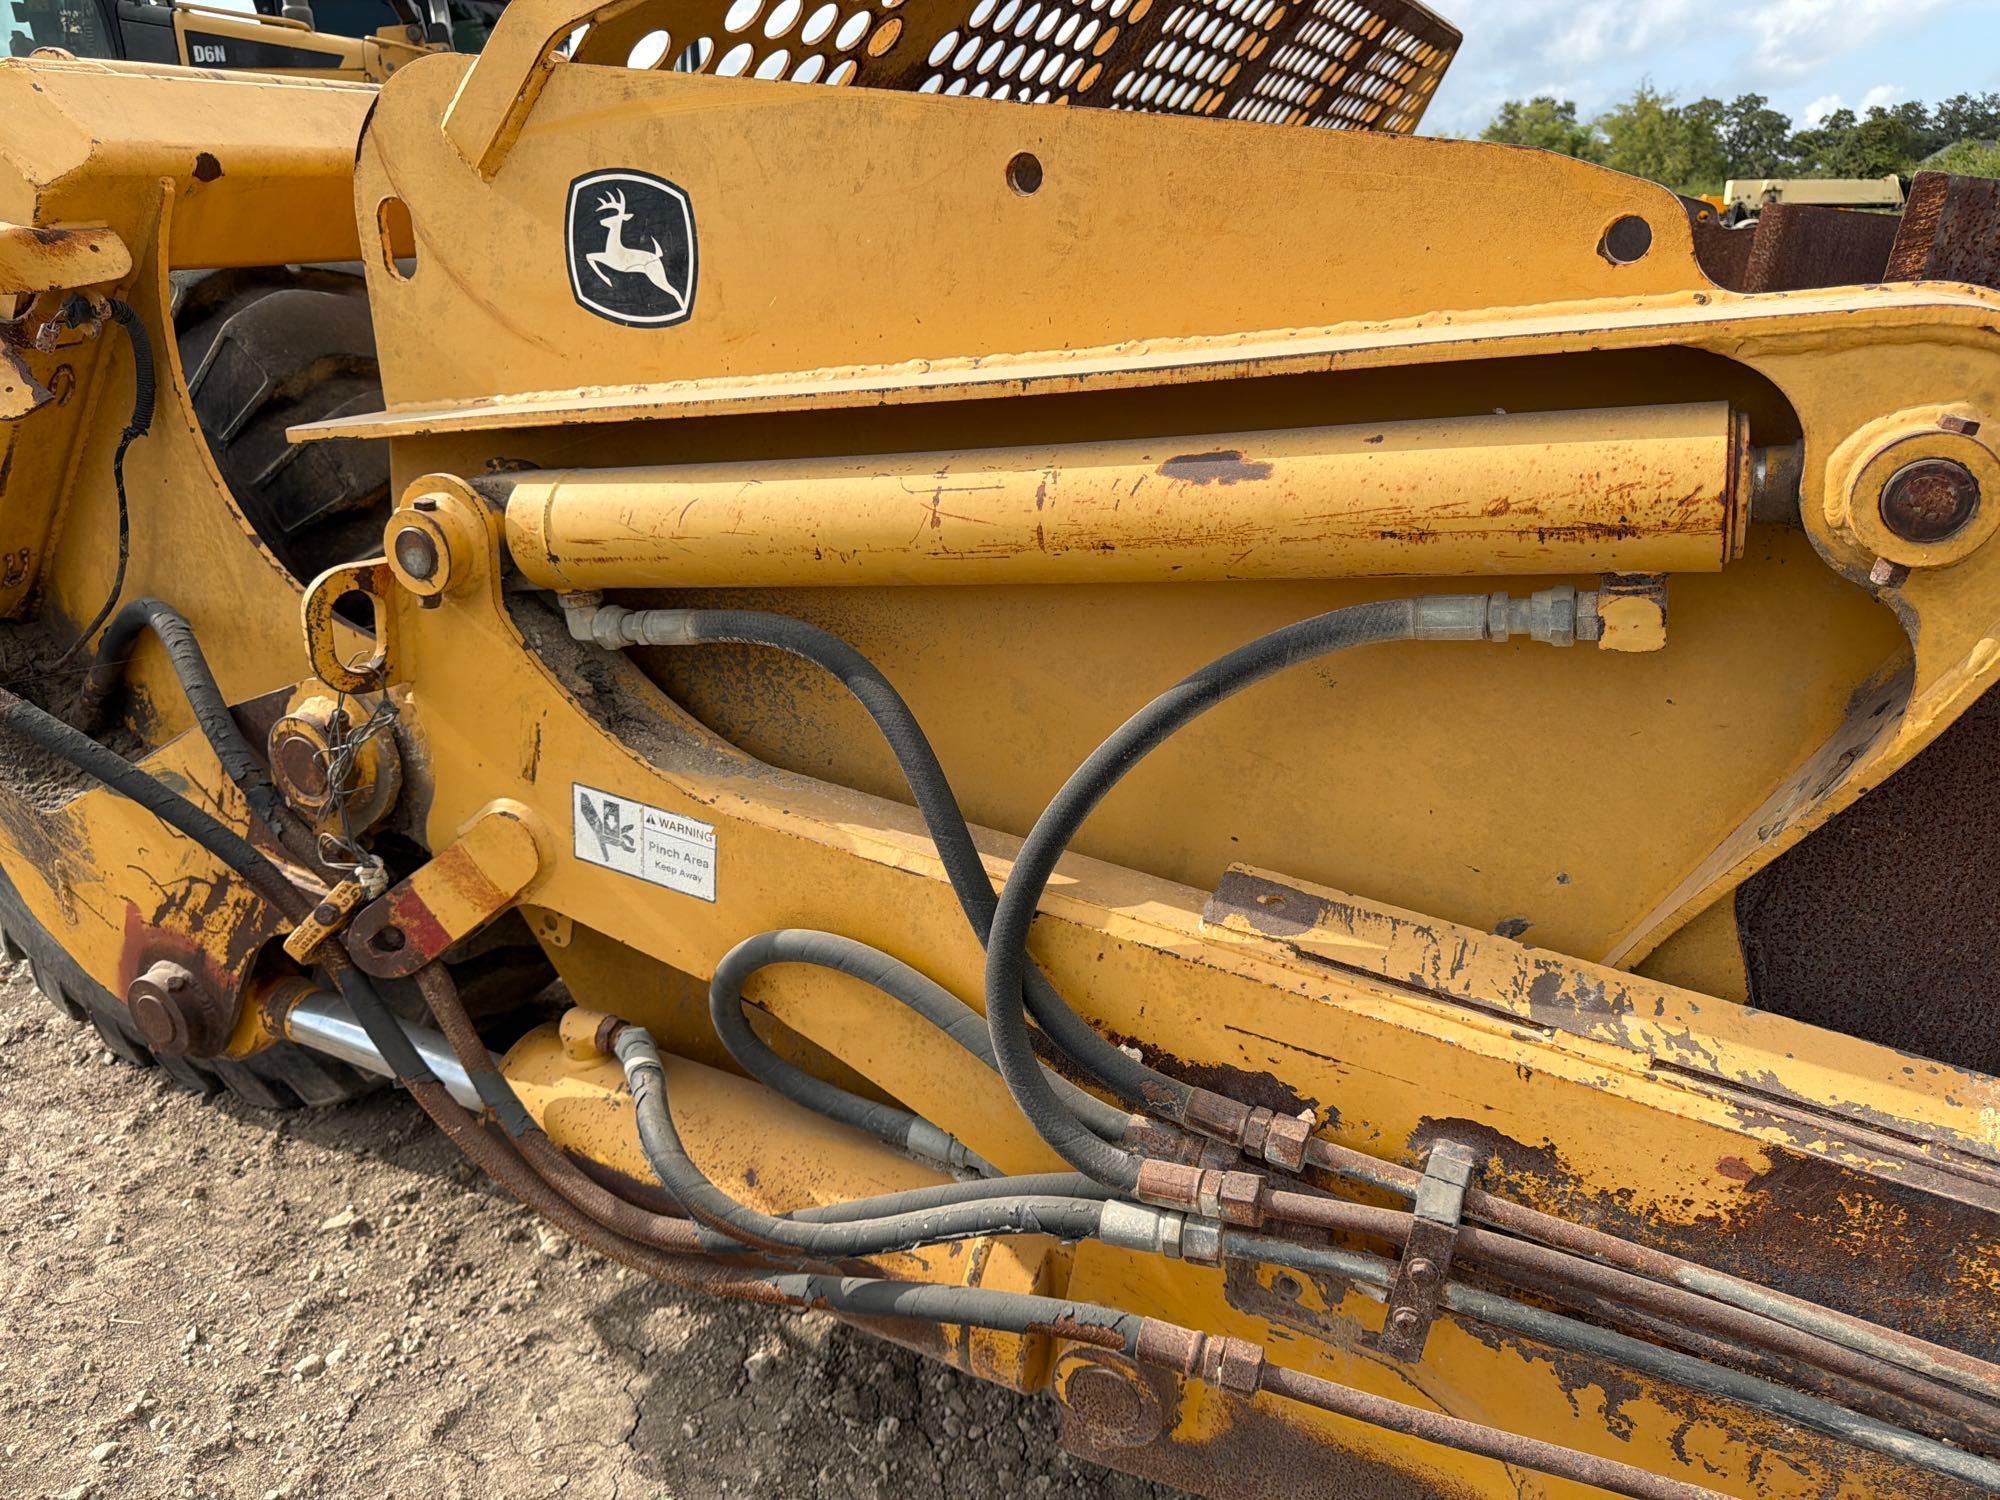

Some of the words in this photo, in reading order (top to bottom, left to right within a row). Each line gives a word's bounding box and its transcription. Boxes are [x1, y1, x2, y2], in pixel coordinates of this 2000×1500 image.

[193, 45, 226, 62] D6N
[659, 817, 713, 842] WARNING
[649, 841, 680, 859] Pinch
[683, 853, 709, 869] Area
[655, 861, 677, 875] Keep
[679, 869, 703, 884] Away
